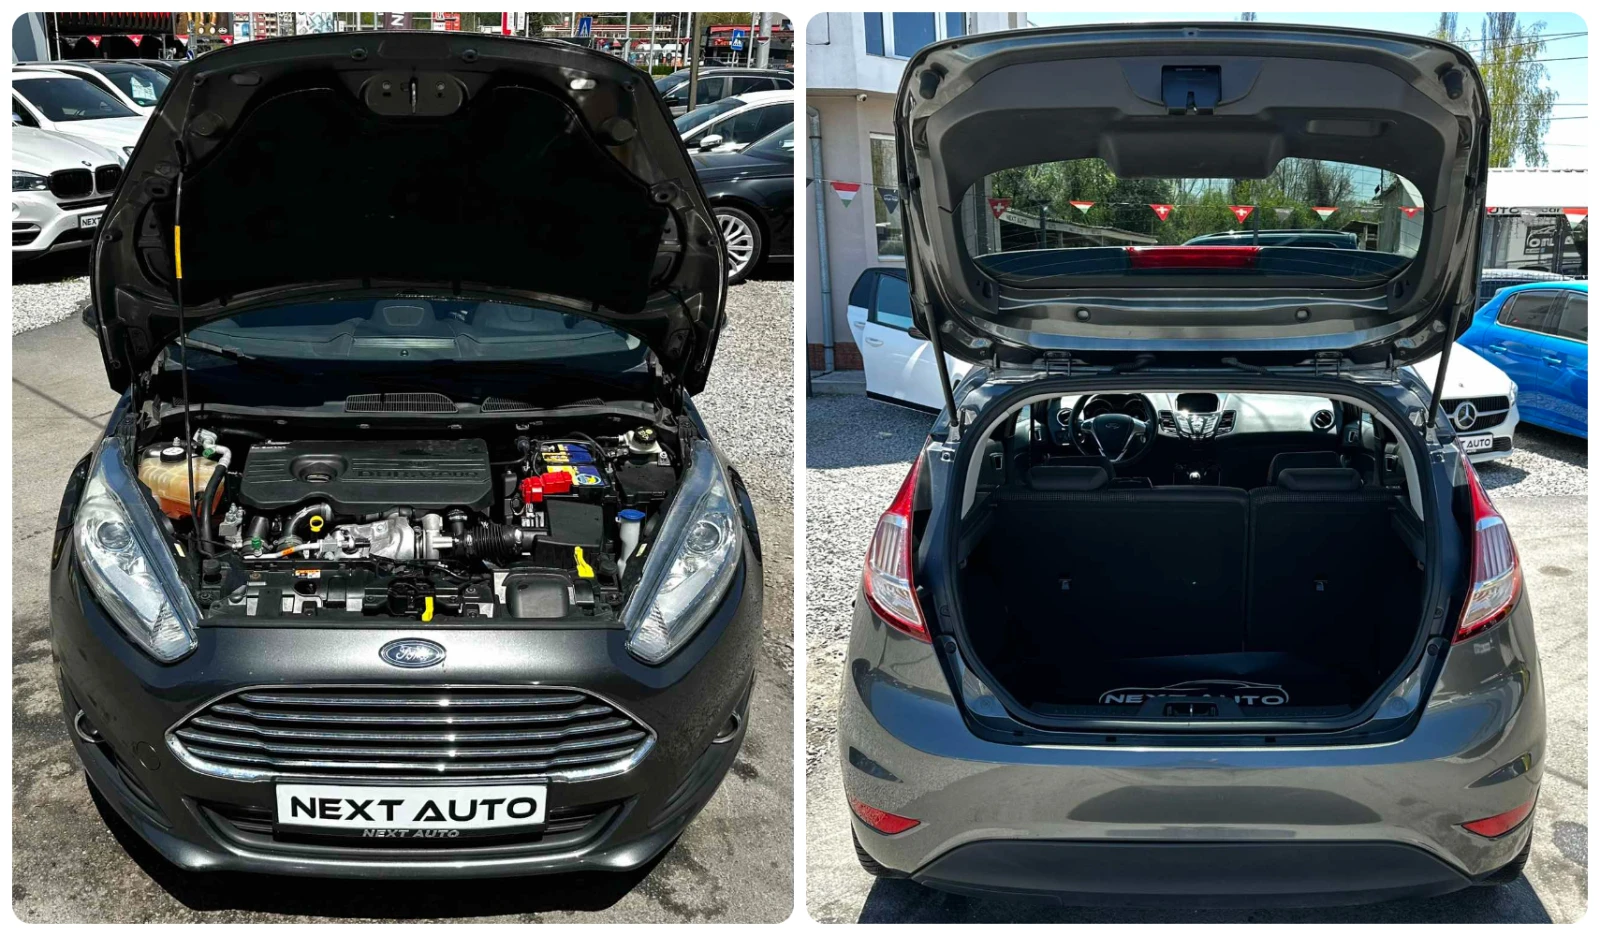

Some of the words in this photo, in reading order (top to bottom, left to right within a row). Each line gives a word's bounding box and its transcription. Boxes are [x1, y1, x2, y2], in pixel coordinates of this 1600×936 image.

[1467, 439, 1490, 448] AUTO
[290, 795, 405, 822] NEXT
[412, 796, 537, 822] AUTO
[362, 828, 409, 838] NEXT
[413, 829, 460, 838] AUTO
